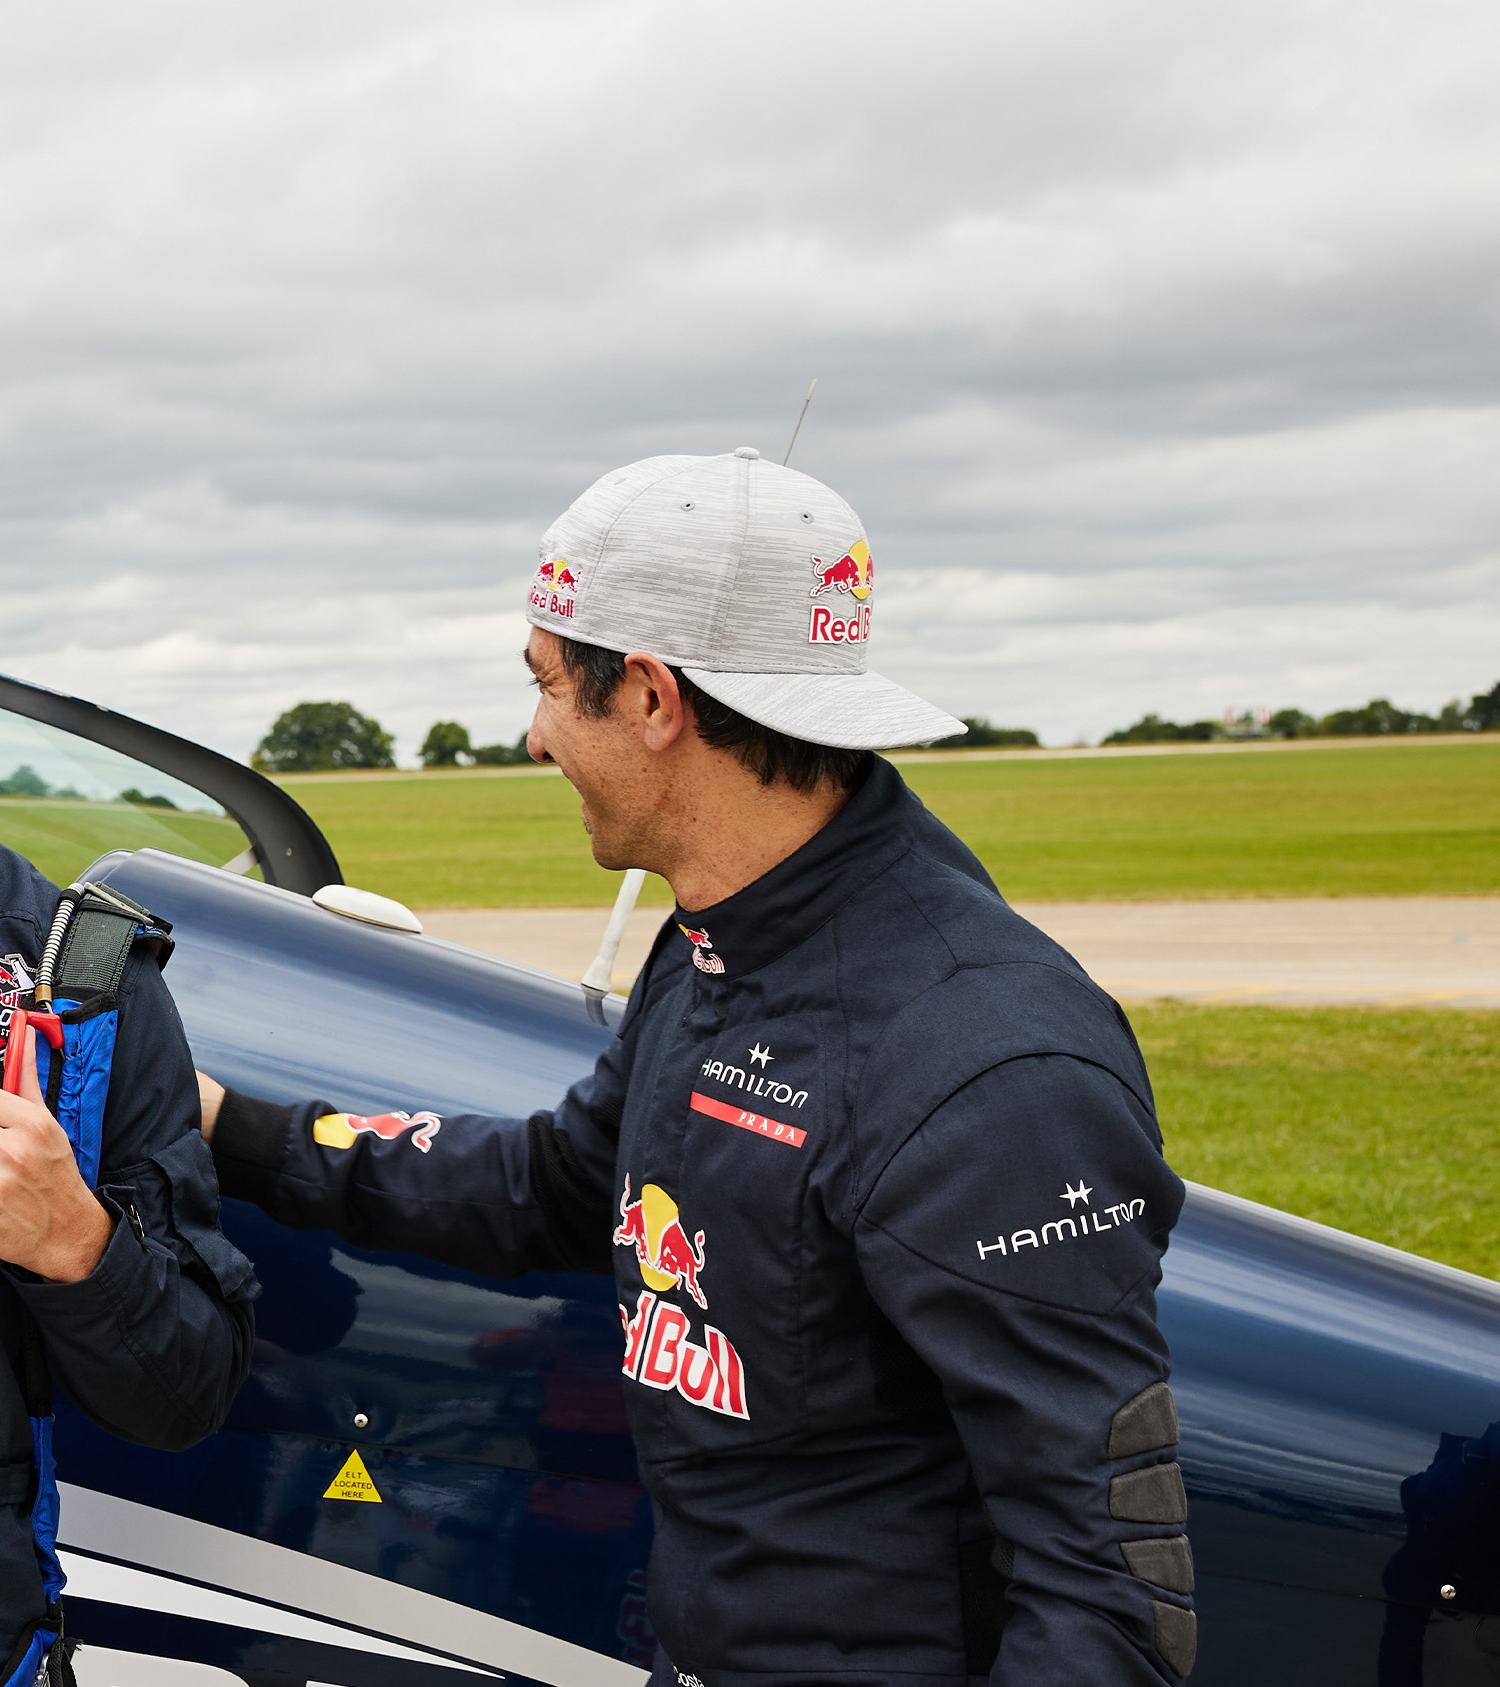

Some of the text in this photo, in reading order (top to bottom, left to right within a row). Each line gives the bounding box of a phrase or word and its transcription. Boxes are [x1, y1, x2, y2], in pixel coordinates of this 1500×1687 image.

[550, 594, 574, 618] Bull
[809, 604, 862, 643] Red
[701, 1059, 809, 1108] HAMILTON
[738, 1112, 795, 1140] PRADA
[976, 1198, 1146, 1260] HAMILTON
[640, 1301, 749, 1419] Bull
[334, 1480, 373, 1490] LOCATED
[345, 1471, 363, 1479] ELT
[341, 1490, 365, 1499] HERE
